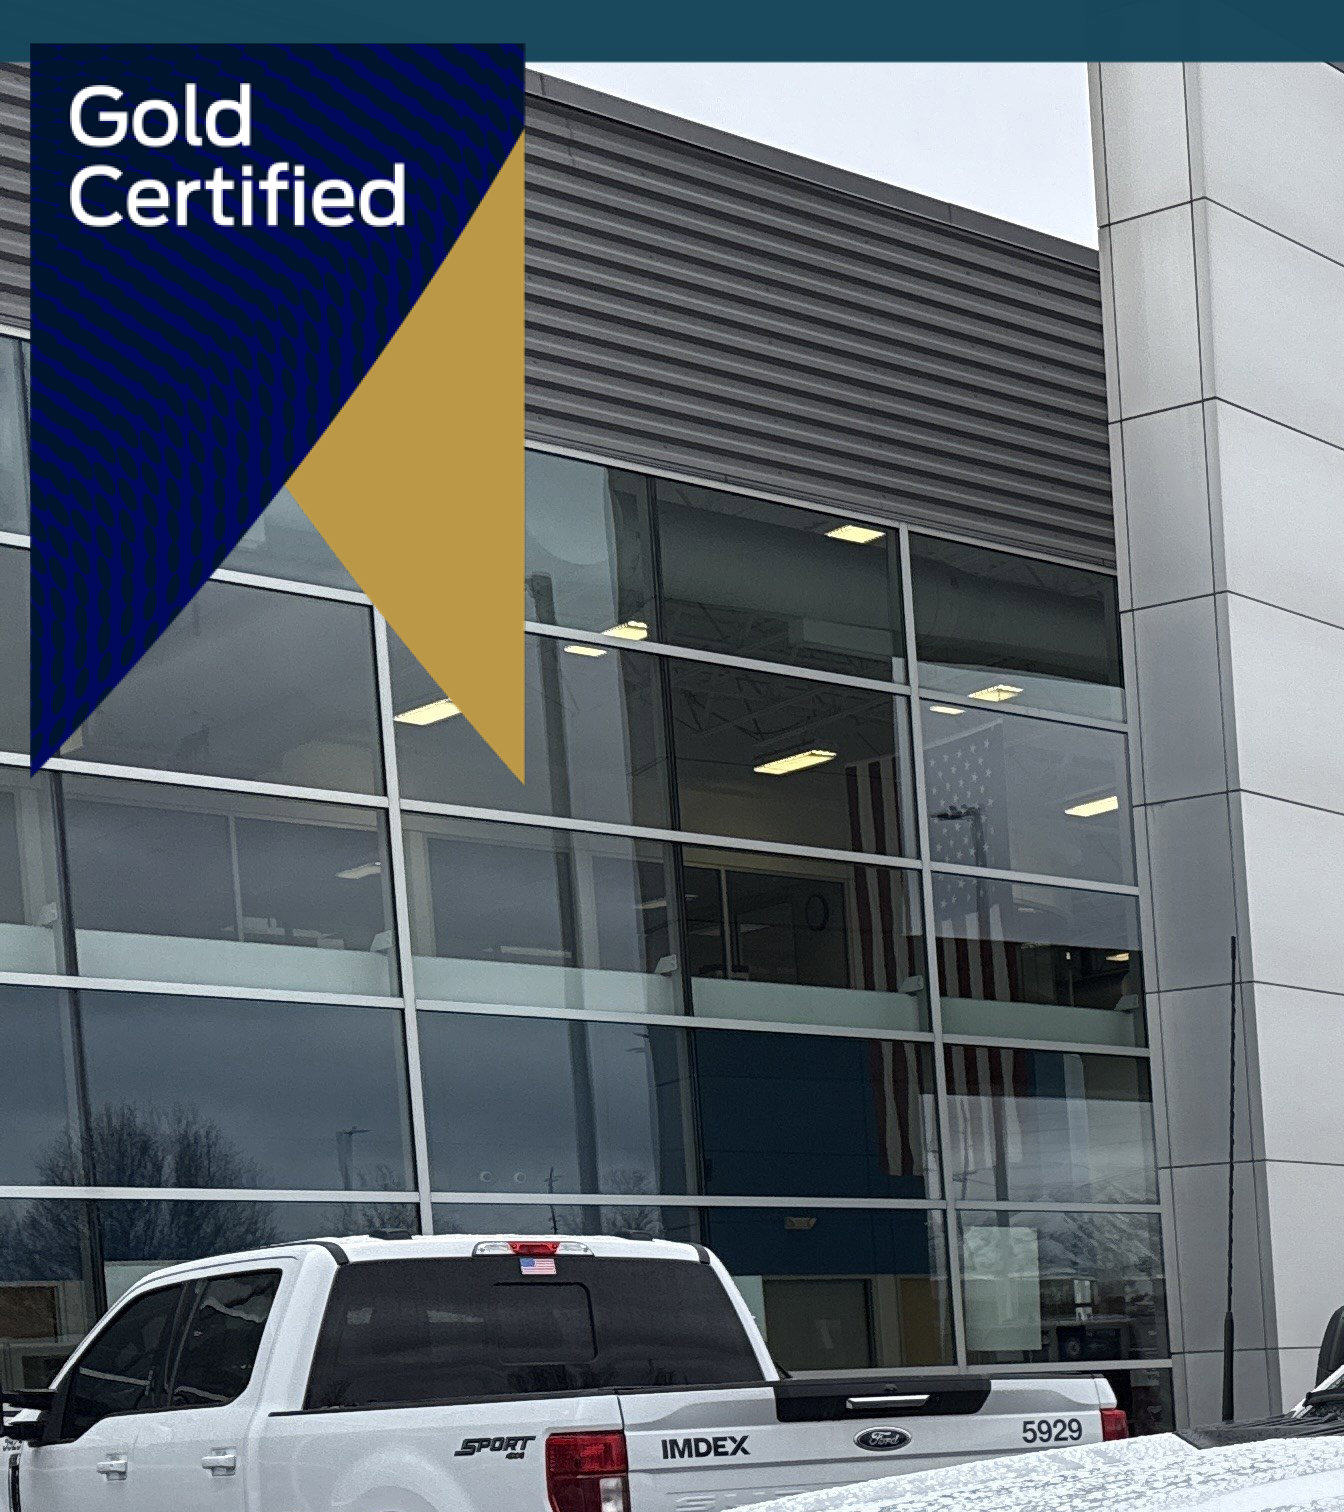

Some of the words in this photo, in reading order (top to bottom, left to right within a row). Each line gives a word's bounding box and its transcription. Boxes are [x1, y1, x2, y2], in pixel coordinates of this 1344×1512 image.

[868, 1431, 901, 1446] Ford
[1022, 1418, 1083, 1444] 5929
[454, 1436, 536, 1457] SPORT
[661, 1435, 751, 1460] IMDEX
